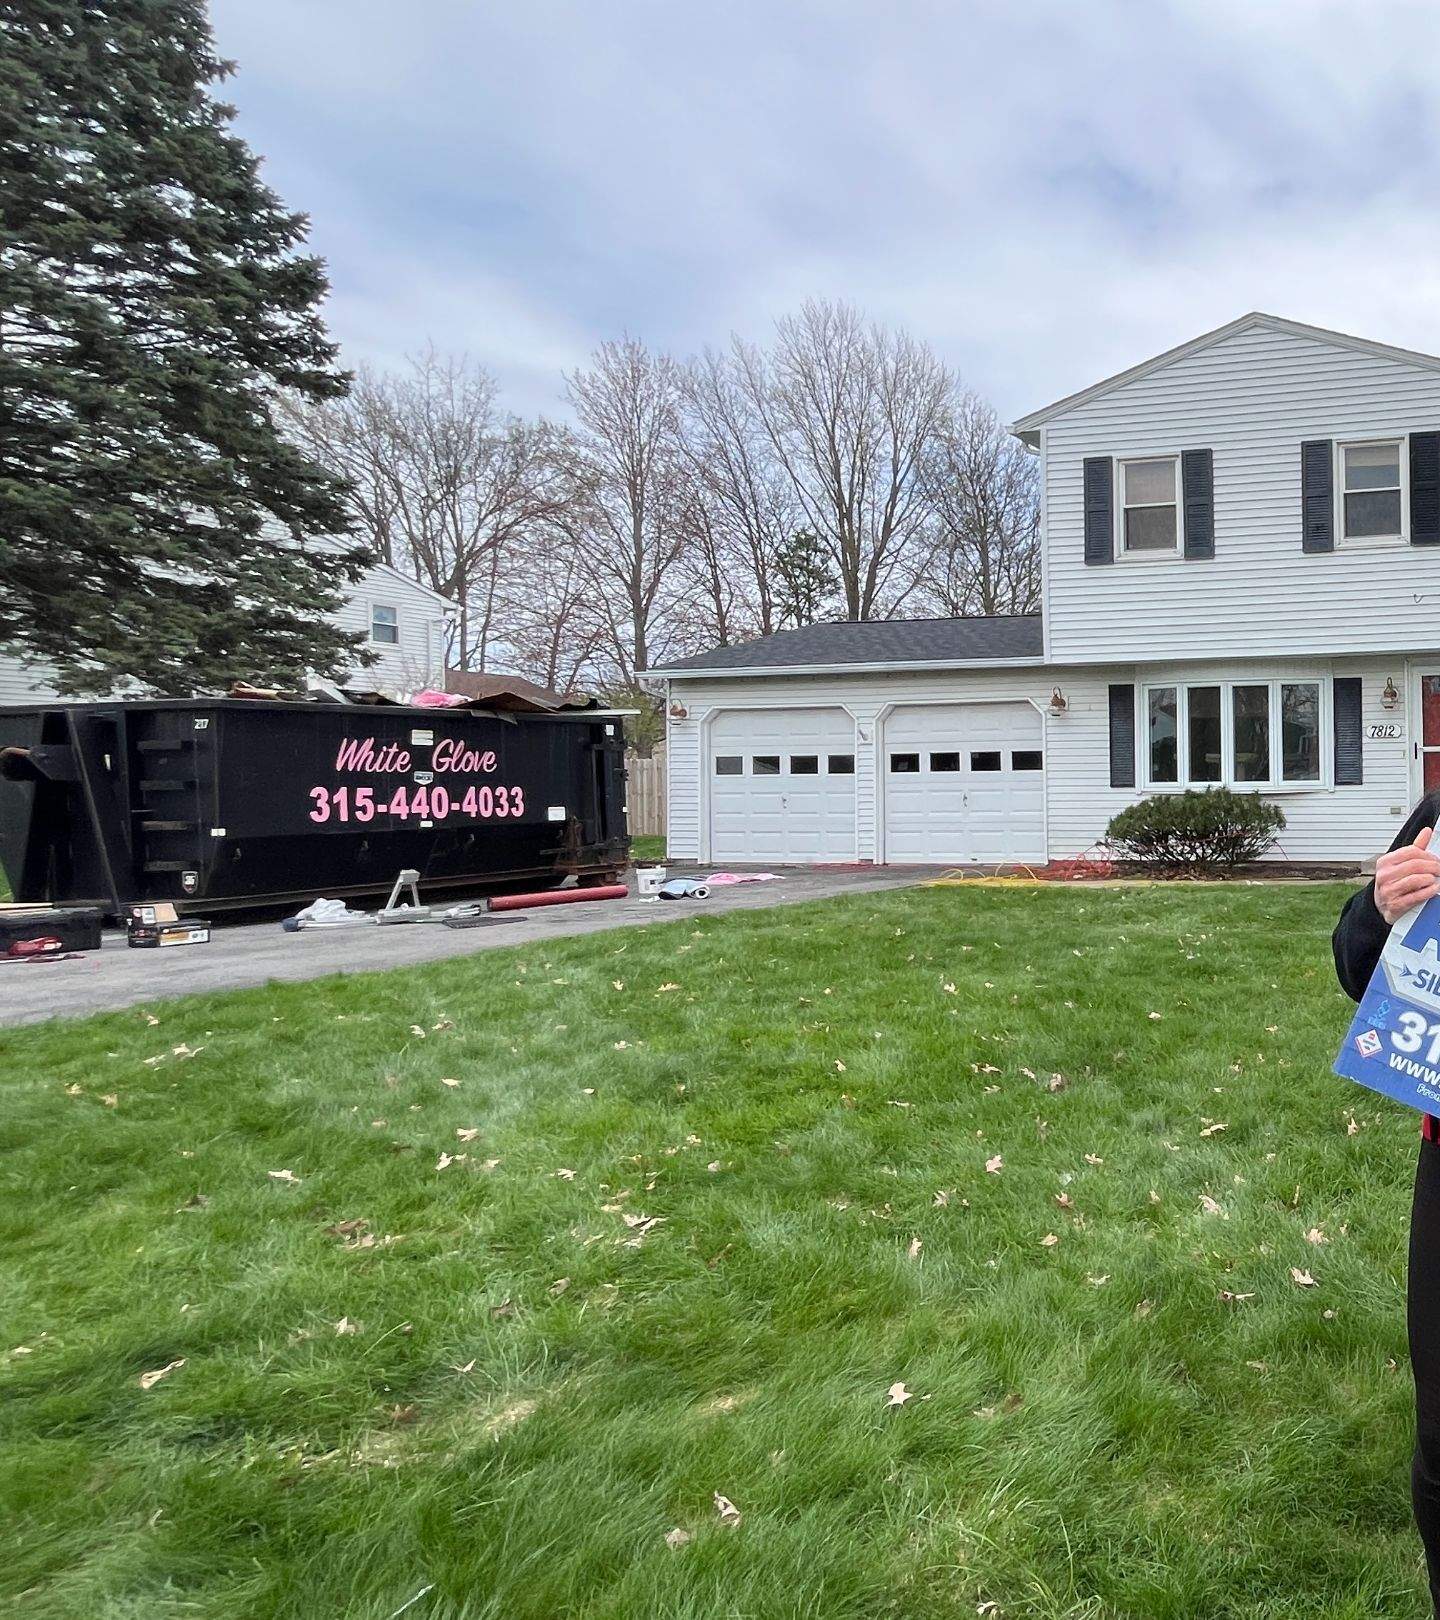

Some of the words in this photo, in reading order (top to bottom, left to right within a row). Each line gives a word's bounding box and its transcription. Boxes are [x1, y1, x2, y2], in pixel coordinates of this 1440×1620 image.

[1371, 725, 1395, 738] 7812
[336, 737, 412, 773] White
[432, 738, 498, 773] Glove
[309, 786, 525, 823] 315-440-4033
